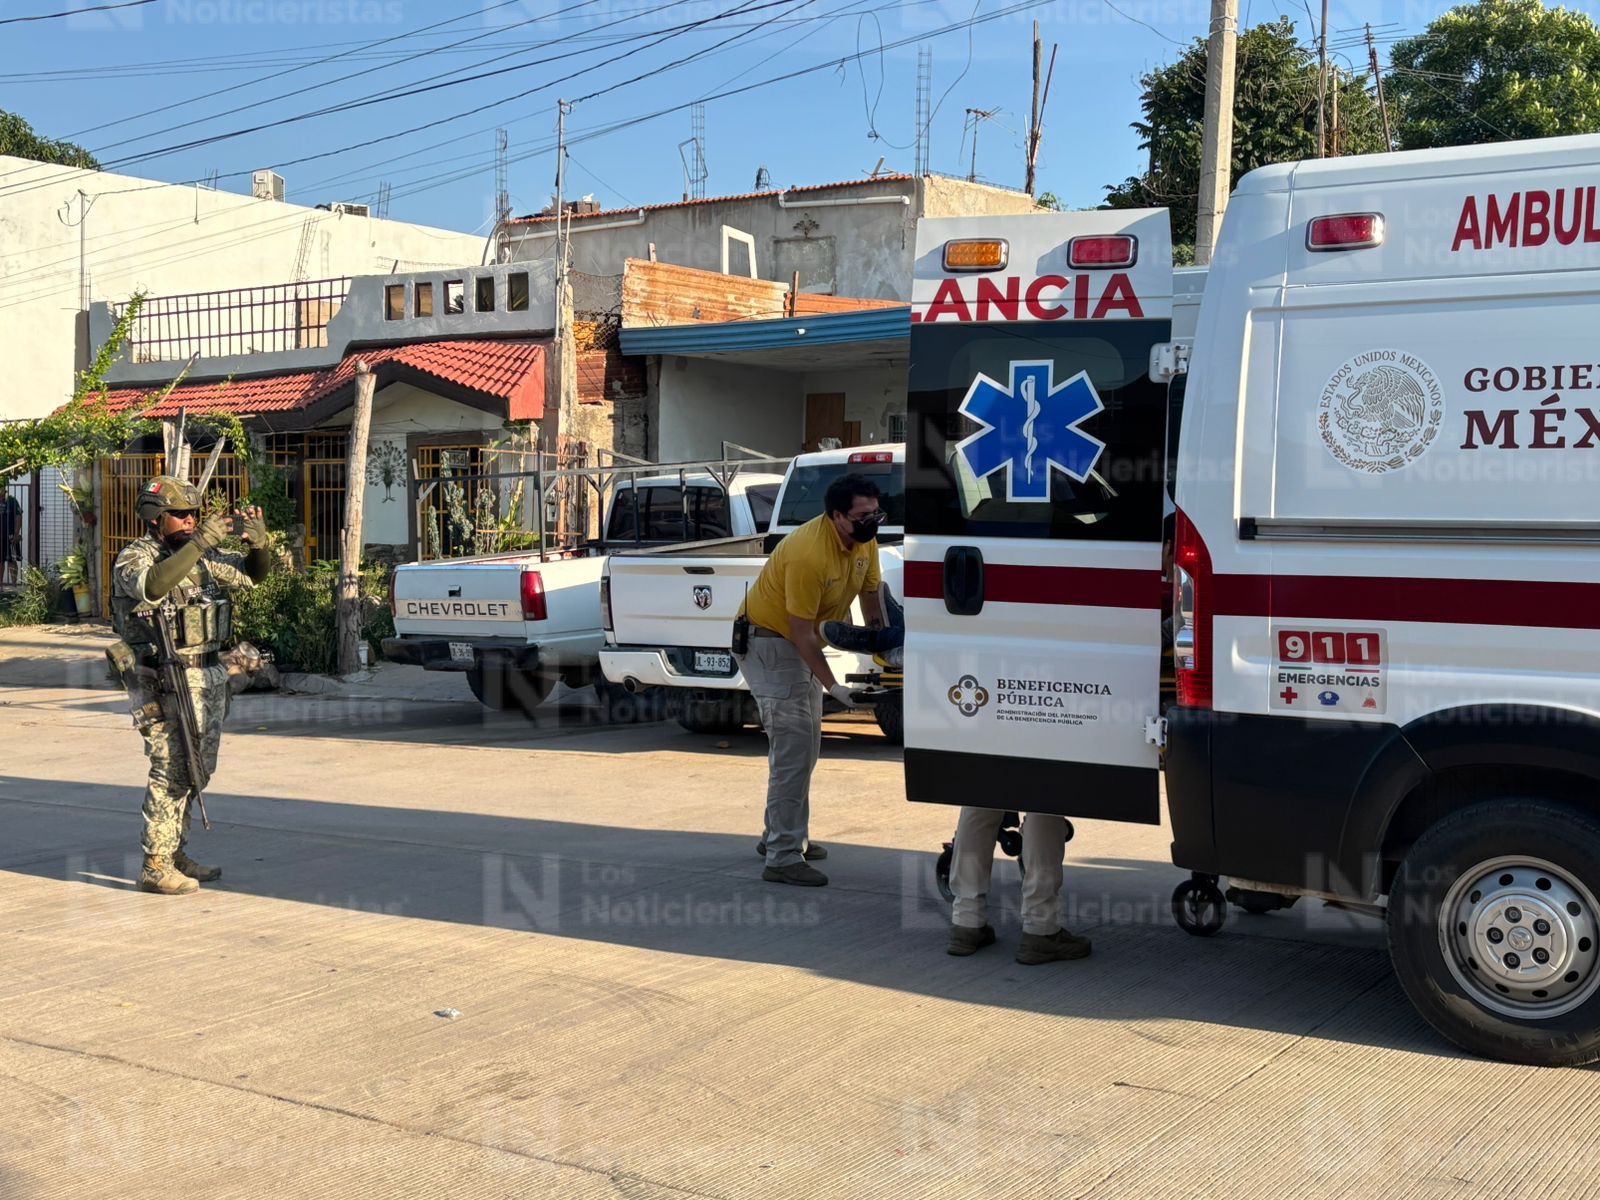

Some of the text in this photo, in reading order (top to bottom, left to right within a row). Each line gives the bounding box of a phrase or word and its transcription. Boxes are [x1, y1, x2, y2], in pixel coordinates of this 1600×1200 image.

[1451, 186, 1600, 252] AMBUL
[1320, 350, 1442, 408] ESTADOS UNIDOS MEXICANOS
[1463, 364, 1600, 392] GOBIE
[1459, 393, 1600, 449] MÉX
[407, 602, 508, 616] CHEVROLET
[1285, 635, 1369, 660] 911
[996, 678, 1112, 696] BENEFICENCIA
[1278, 672, 1380, 688] EMERGENCIAS
[996, 691, 1064, 708] PÚBLICA
[996, 709, 1047, 717] ADMINISTRACIÓN
[1015, 716, 1056, 724] BENEFICENCIA
[1058, 718, 1083, 726] PÚBLICA
